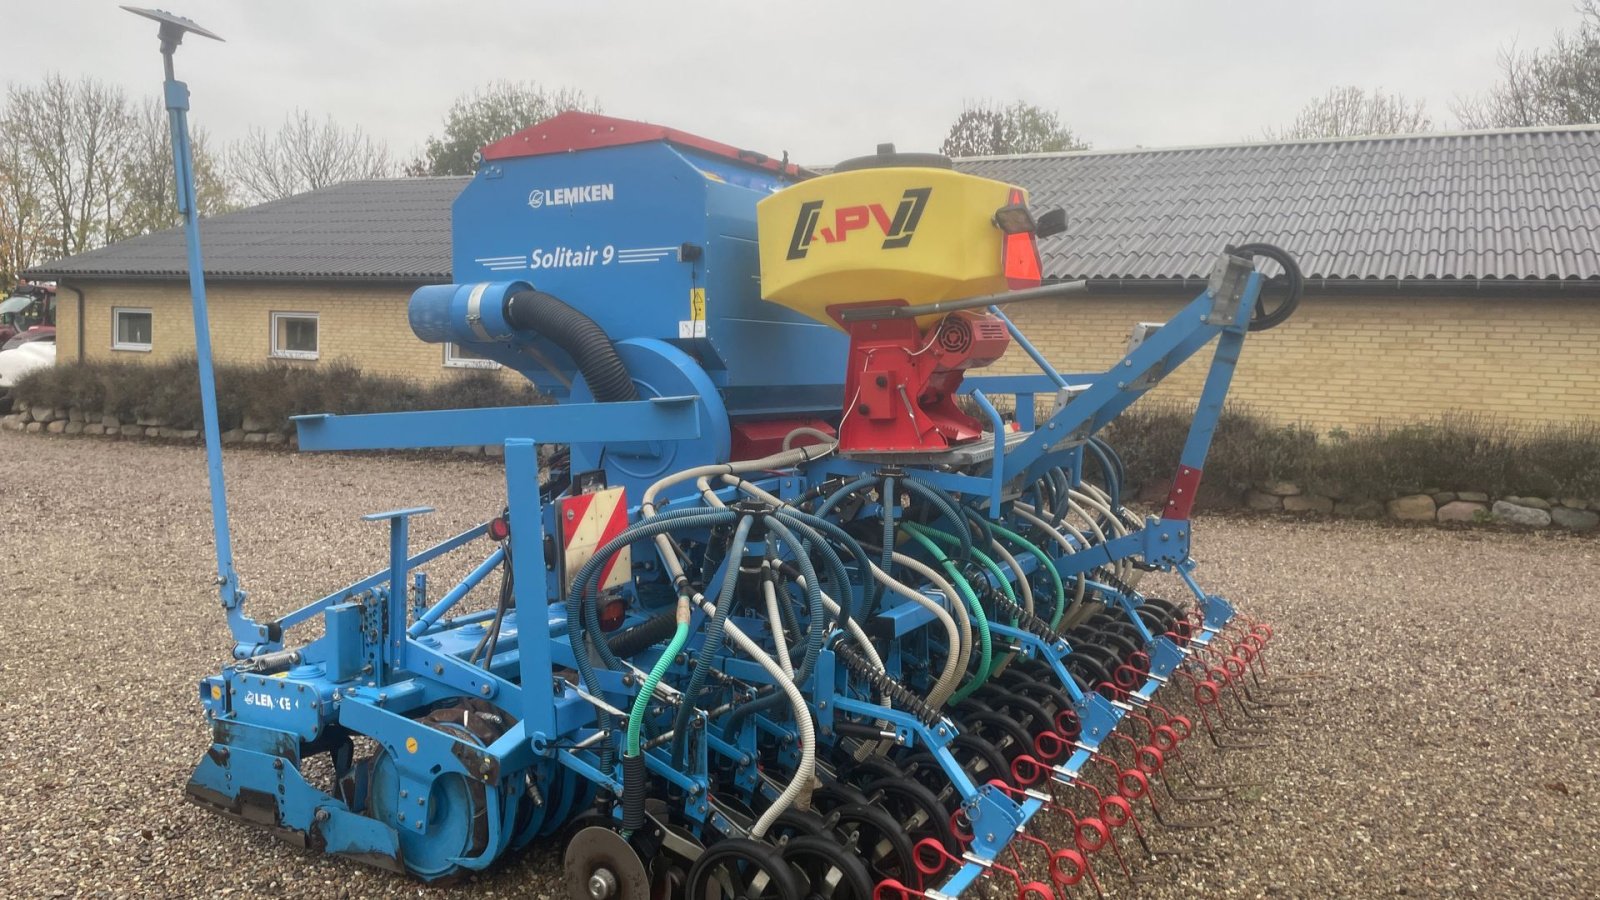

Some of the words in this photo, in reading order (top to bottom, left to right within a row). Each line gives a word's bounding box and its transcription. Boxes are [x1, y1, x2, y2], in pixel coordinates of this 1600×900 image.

[545, 183, 614, 206] LEMKEN
[786, 187, 932, 260] APV
[530, 245, 598, 269] Solitair
[602, 245, 614, 266] 9
